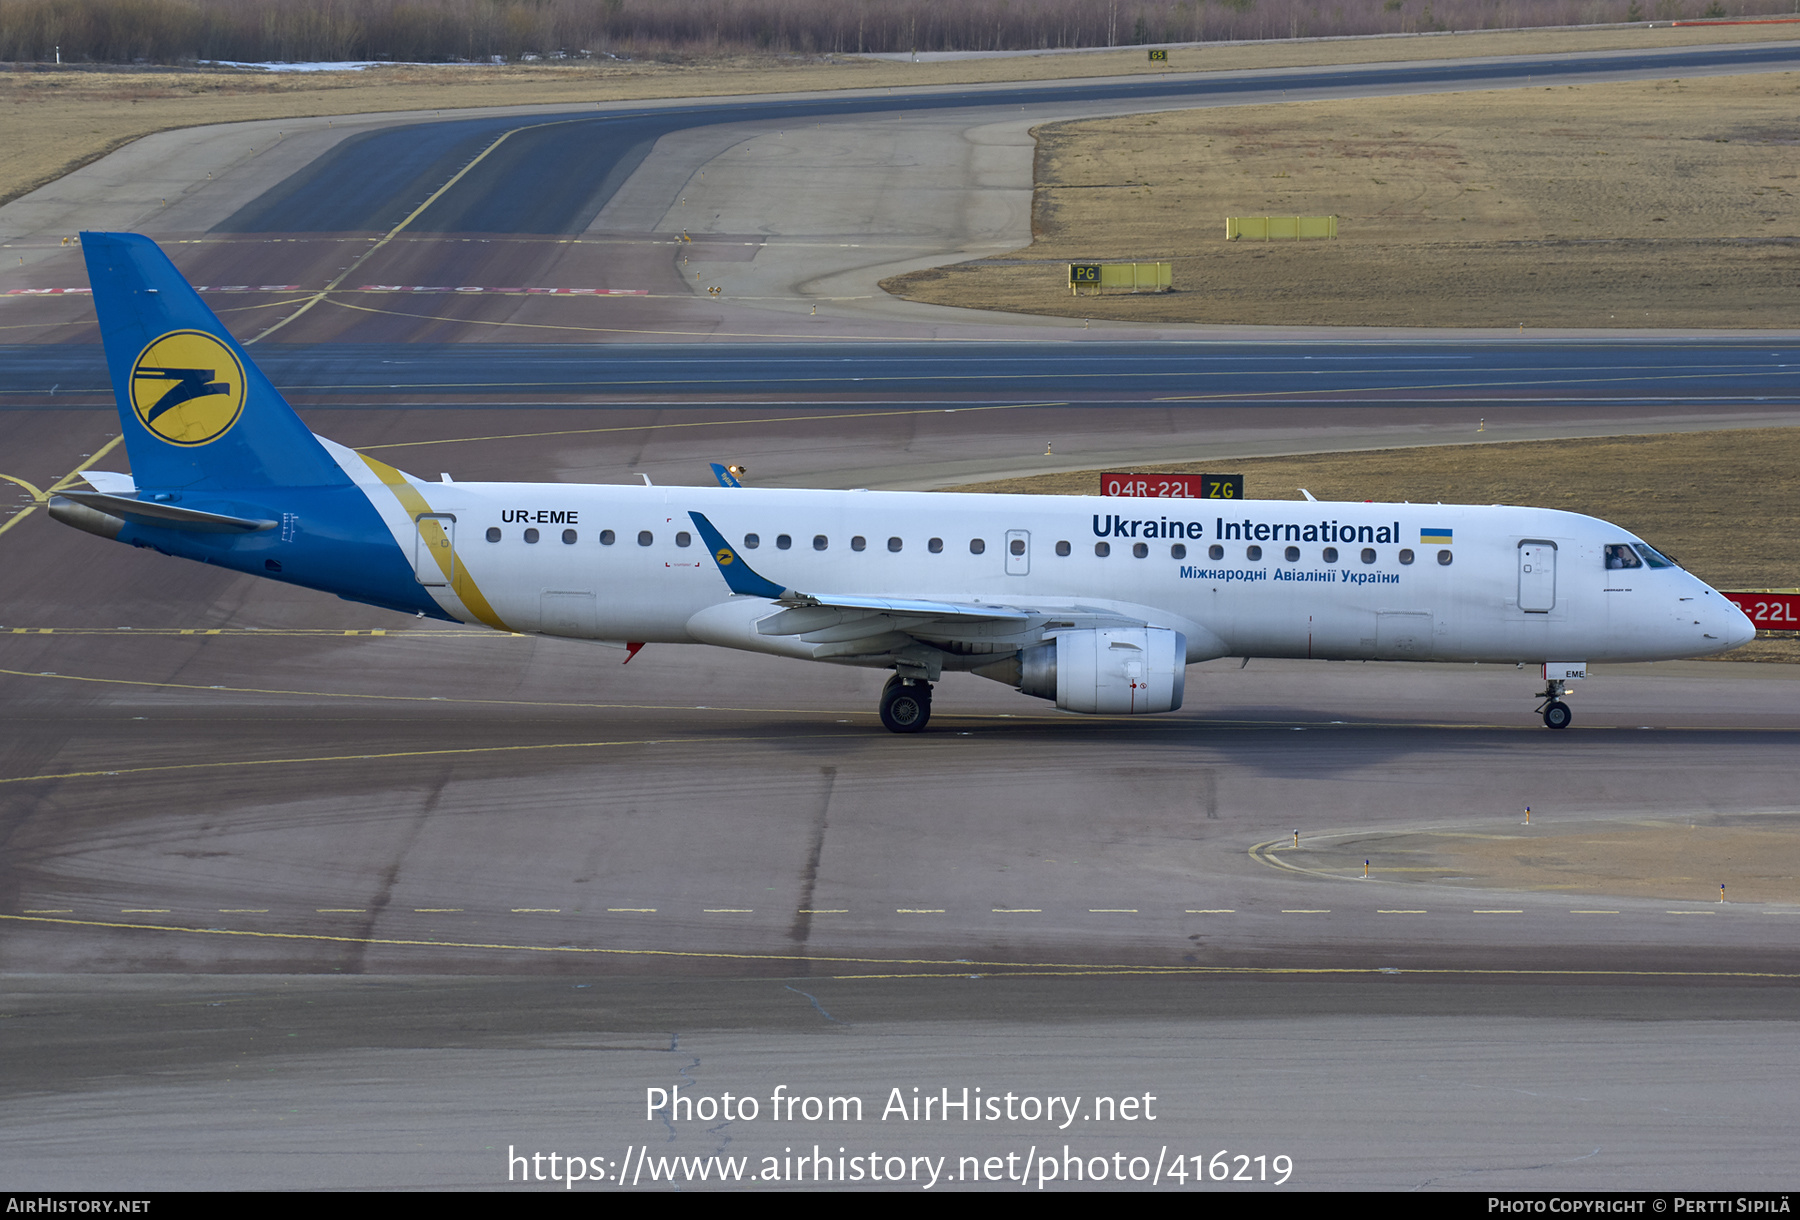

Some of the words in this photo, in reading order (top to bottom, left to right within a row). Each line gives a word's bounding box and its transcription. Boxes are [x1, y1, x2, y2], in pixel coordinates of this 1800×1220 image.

[1151, 51, 1164, 60] G5
[1077, 267, 1095, 280] PG
[1108, 480, 1195, 498] 04R-22L
[1209, 482, 1234, 499] ZG
[501, 509, 579, 525] UR-EME
[1092, 514, 1204, 541] Ukraine
[1216, 517, 1400, 545] International
[1179, 565, 1267, 583] Міжнародні
[1273, 567, 1337, 583] Авіалінії
[1340, 569, 1401, 585] України
[1565, 670, 1585, 678] EME
